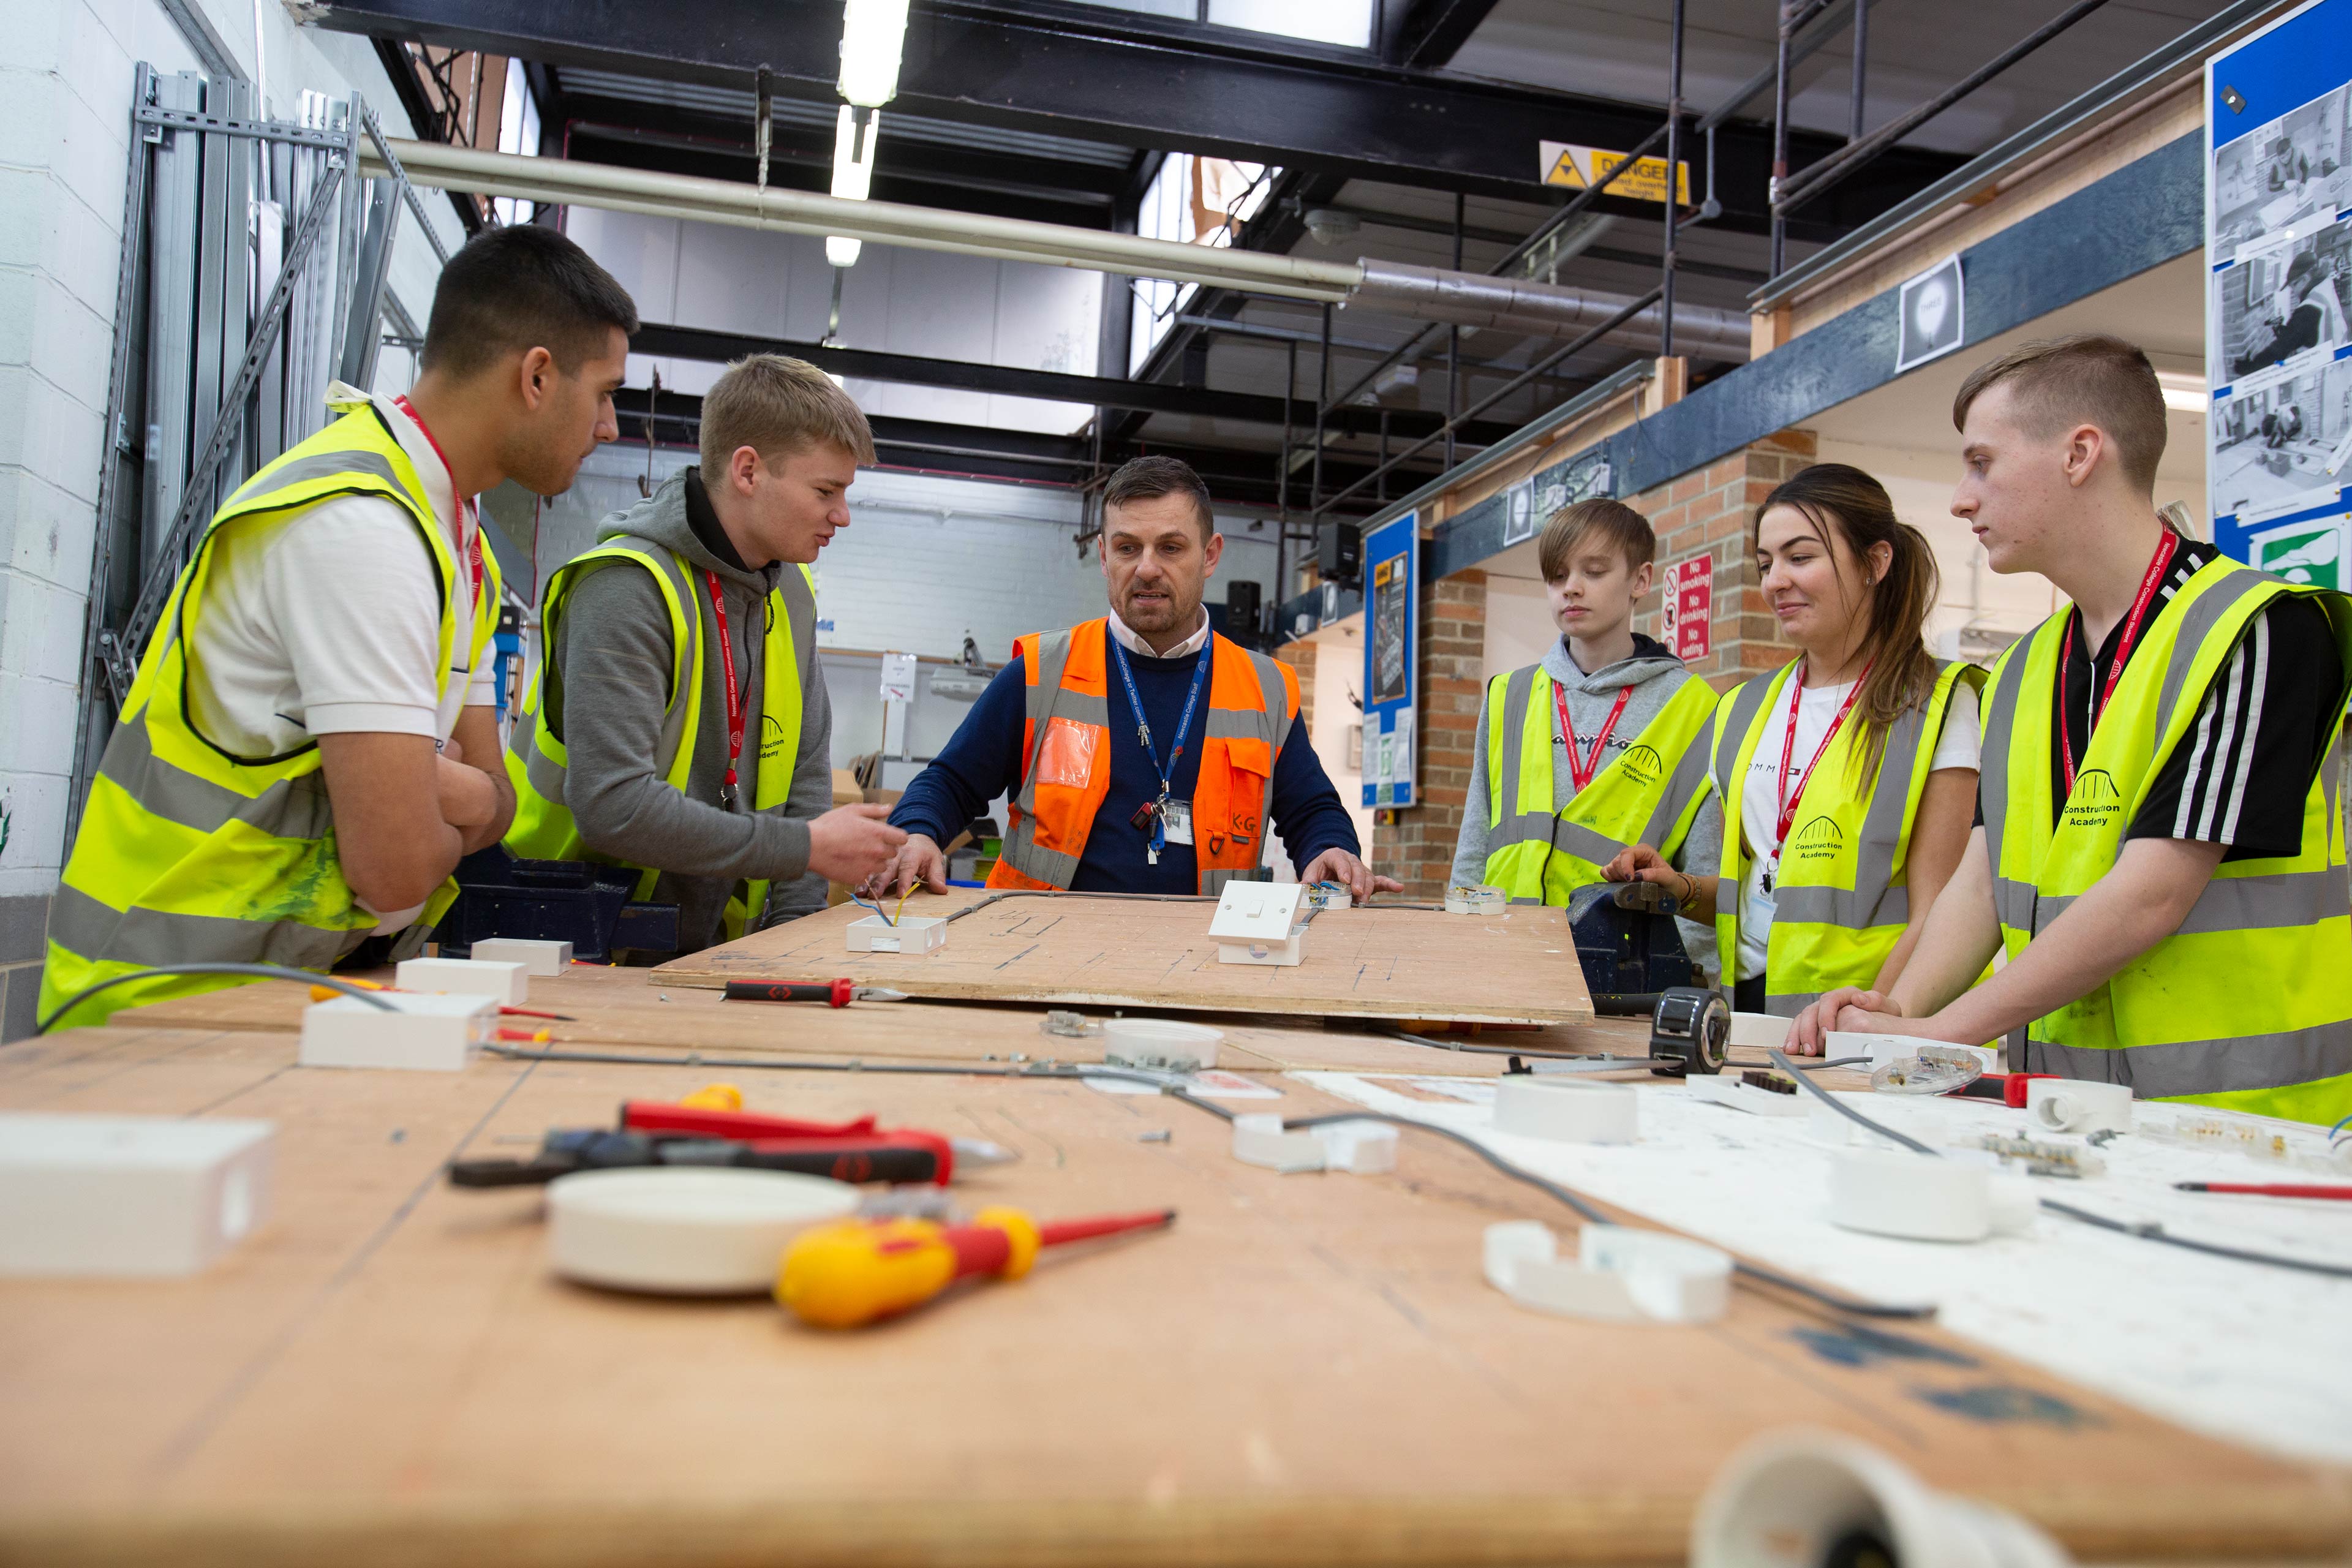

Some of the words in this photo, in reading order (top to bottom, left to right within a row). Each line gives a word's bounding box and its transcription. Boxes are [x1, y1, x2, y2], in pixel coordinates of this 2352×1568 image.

[1690, 562, 1700, 574] No
[2146, 566, 2160, 587] College
[1680, 574, 1709, 592] smoking
[1689, 595, 1700, 608] No
[2132, 587, 2150, 620] Construction
[1679, 608, 1707, 625] drinking
[1687, 628, 1698, 642] No
[2124, 622, 2135, 643] Student
[1681, 642, 1703, 658] eating
[1185, 695, 1196, 713] College
[1620, 760, 1656, 783] Construction
[1622, 769, 1647, 787] Academy
[2064, 805, 2120, 813] Construction
